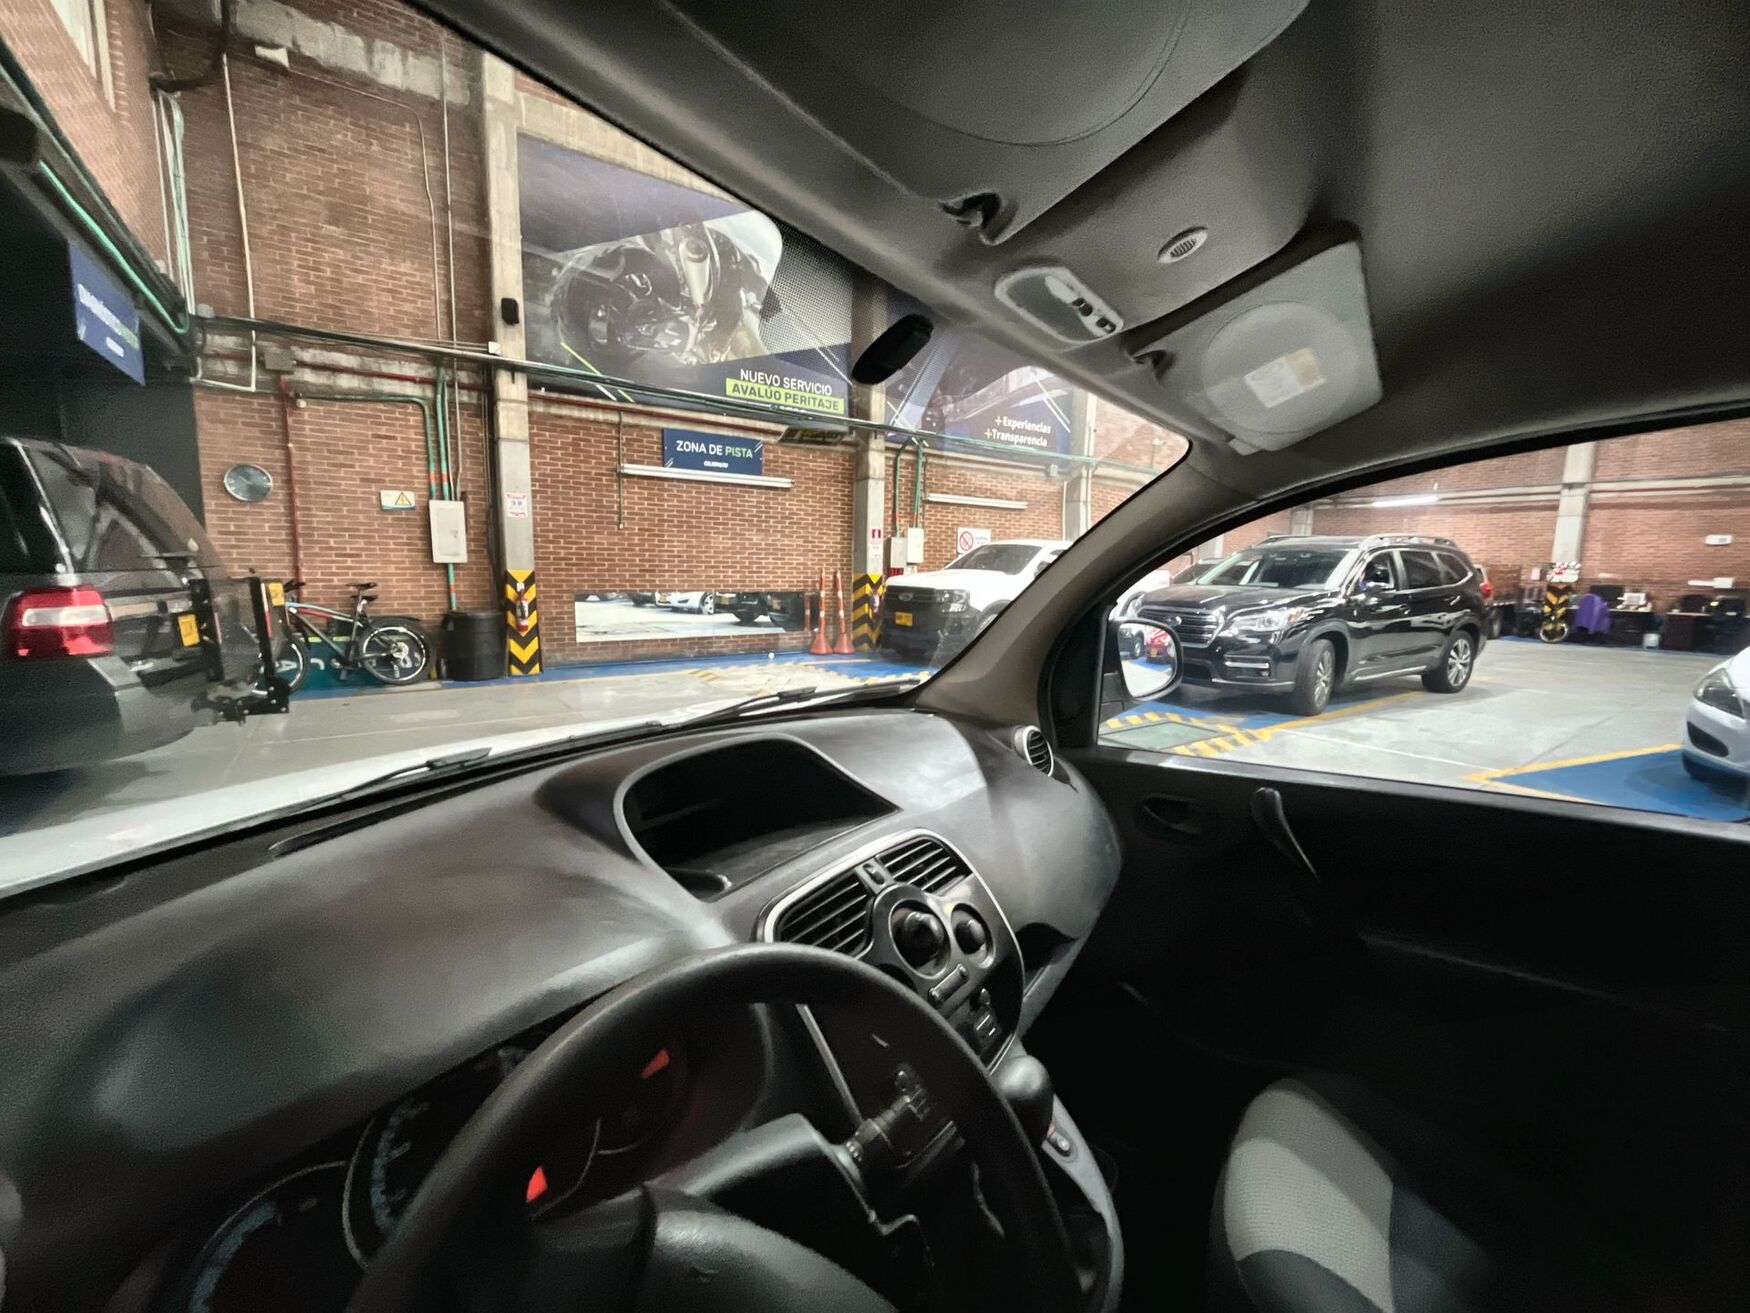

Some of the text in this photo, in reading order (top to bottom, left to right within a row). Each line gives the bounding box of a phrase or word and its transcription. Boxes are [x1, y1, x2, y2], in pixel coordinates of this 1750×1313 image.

[740, 368, 832, 396] NUEVO SERVICIO
[784, 392, 840, 411] PERITAJE
[676, 440, 753, 459] ZONA DE PISTA
